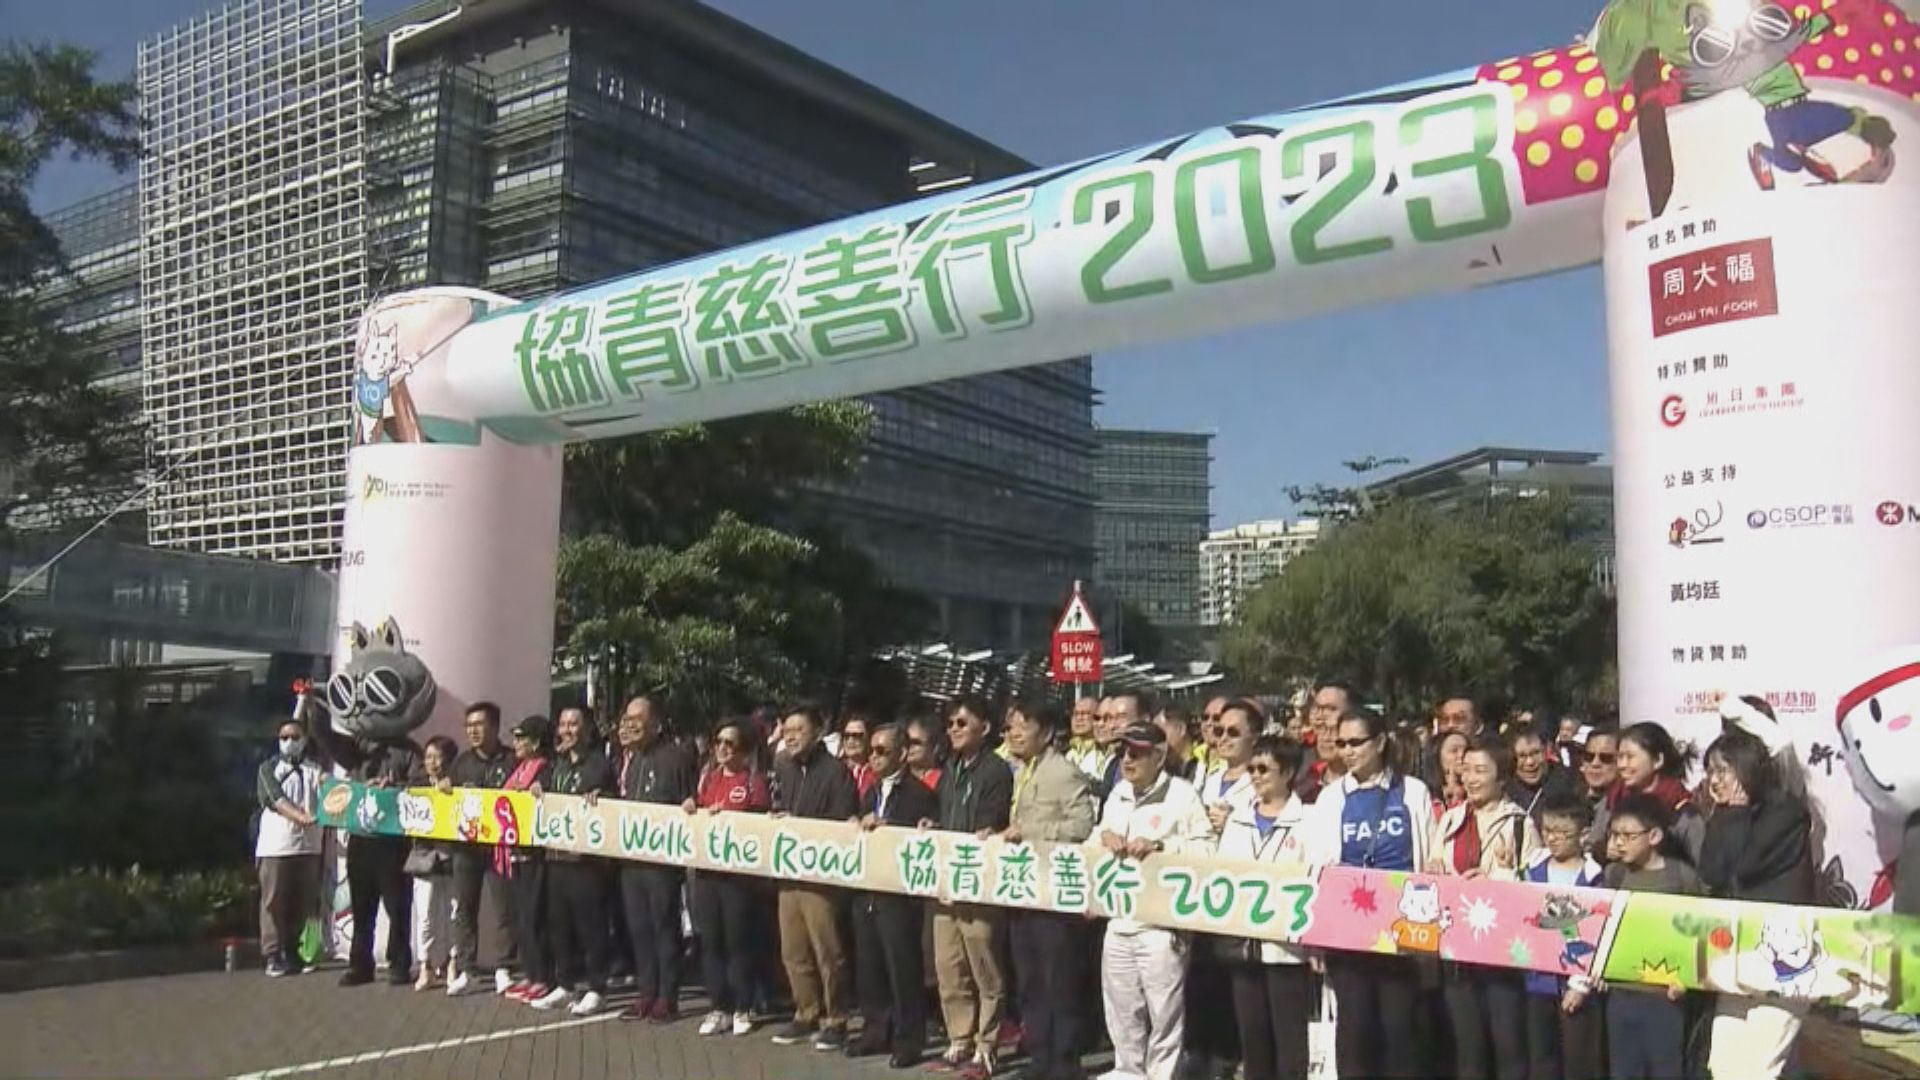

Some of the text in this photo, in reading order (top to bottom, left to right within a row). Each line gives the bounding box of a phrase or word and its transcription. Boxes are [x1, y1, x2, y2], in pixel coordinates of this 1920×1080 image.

[514, 92, 1511, 413] 協青慈善行 2023
[1662, 252, 1755, 299] 周大福
[1664, 464, 1737, 488] 公益支持
[1769, 504, 1827, 524] CSOP
[1061, 641, 1095, 654] SLOW
[534, 801, 1315, 932] Let's Walk the Road 協青慈善行 2023
